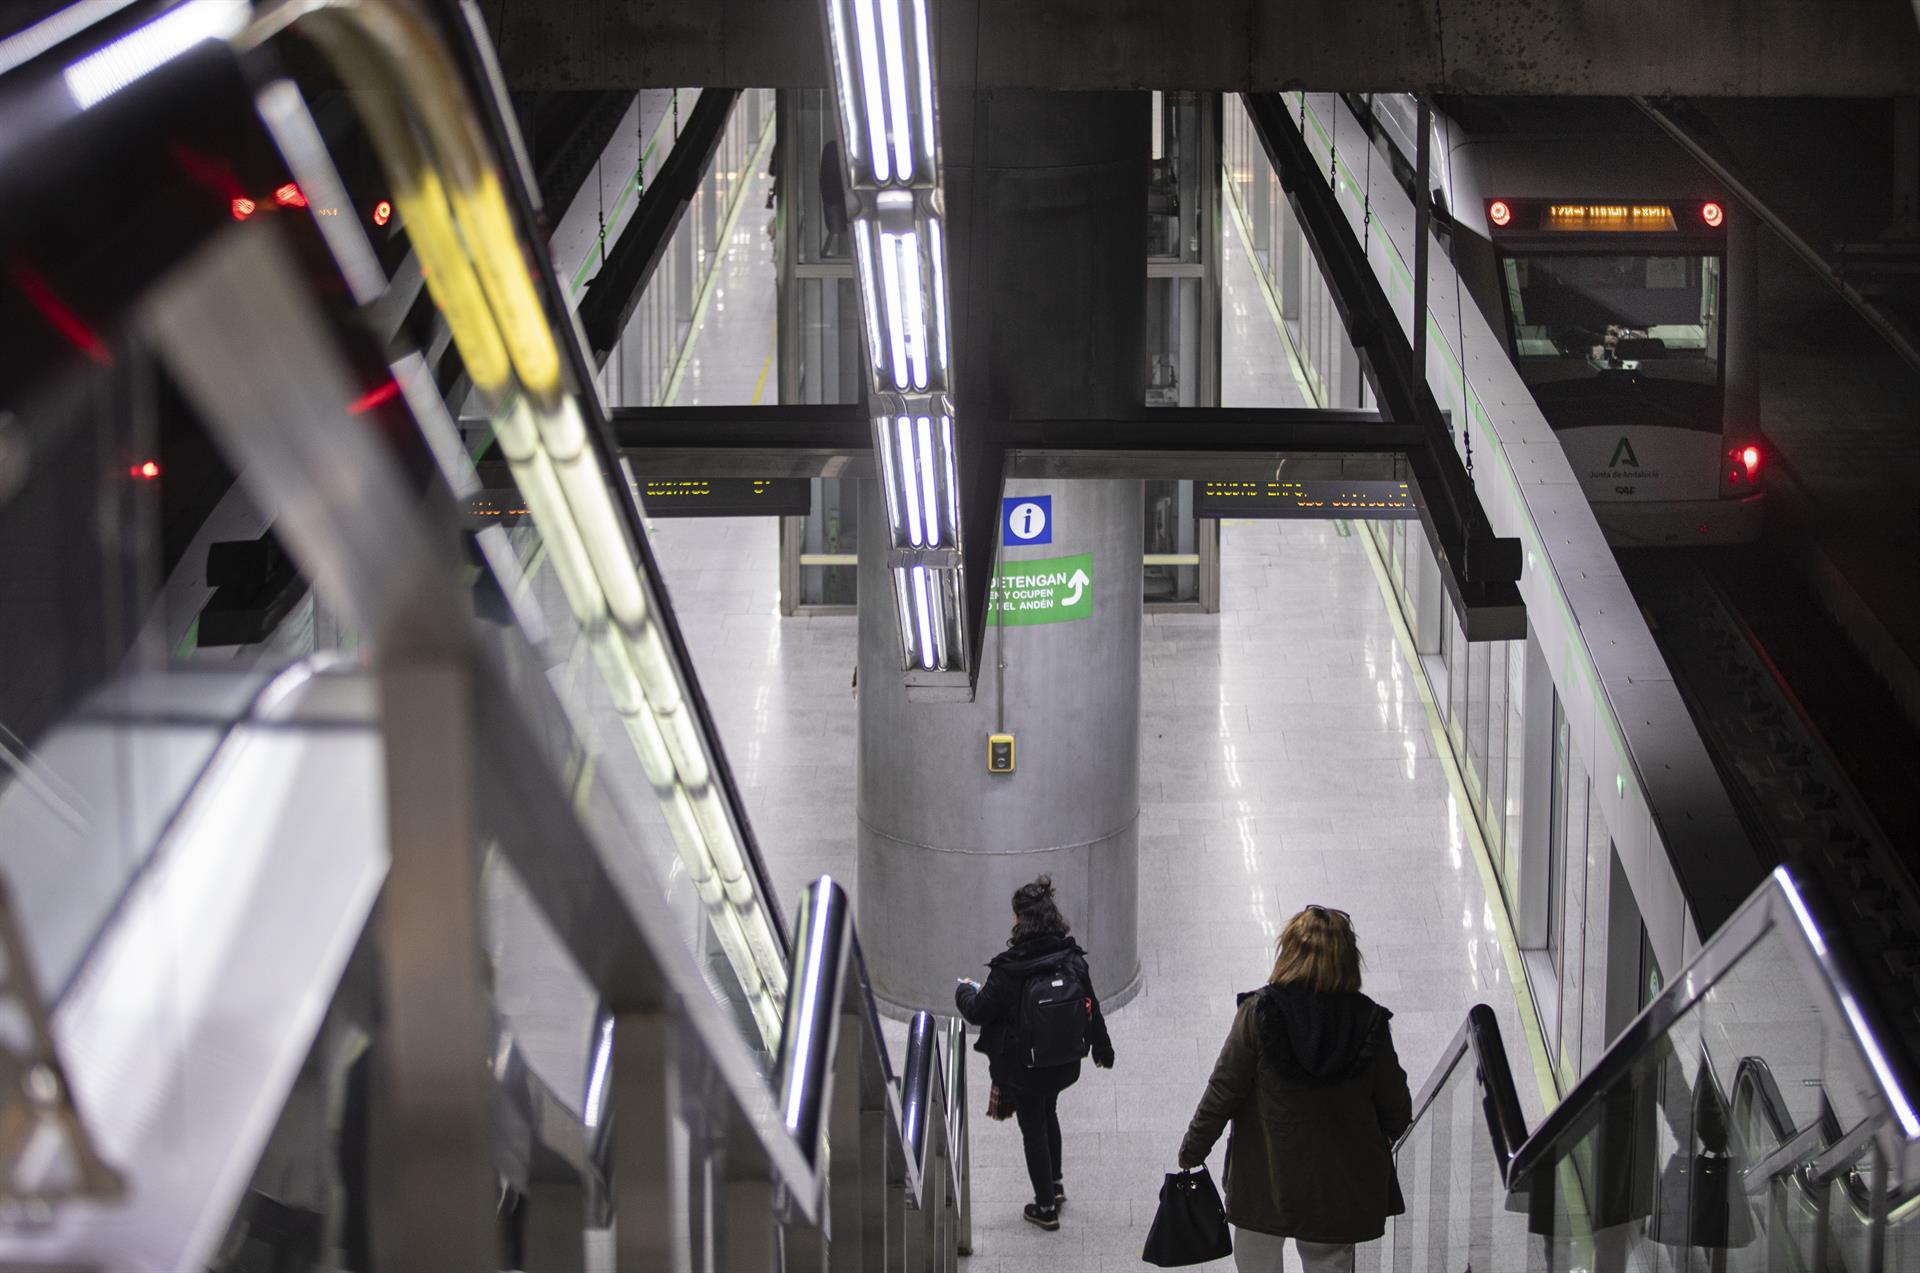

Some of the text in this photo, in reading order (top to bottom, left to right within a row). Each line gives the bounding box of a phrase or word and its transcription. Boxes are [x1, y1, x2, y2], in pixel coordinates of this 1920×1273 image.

[1590, 471, 1611, 479] Junta
[1612, 471, 1621, 479] de
[1003, 590, 1011, 599] Y
[1012, 588, 1054, 599] OCUPEN
[1019, 598, 1054, 610] ANDÉN
